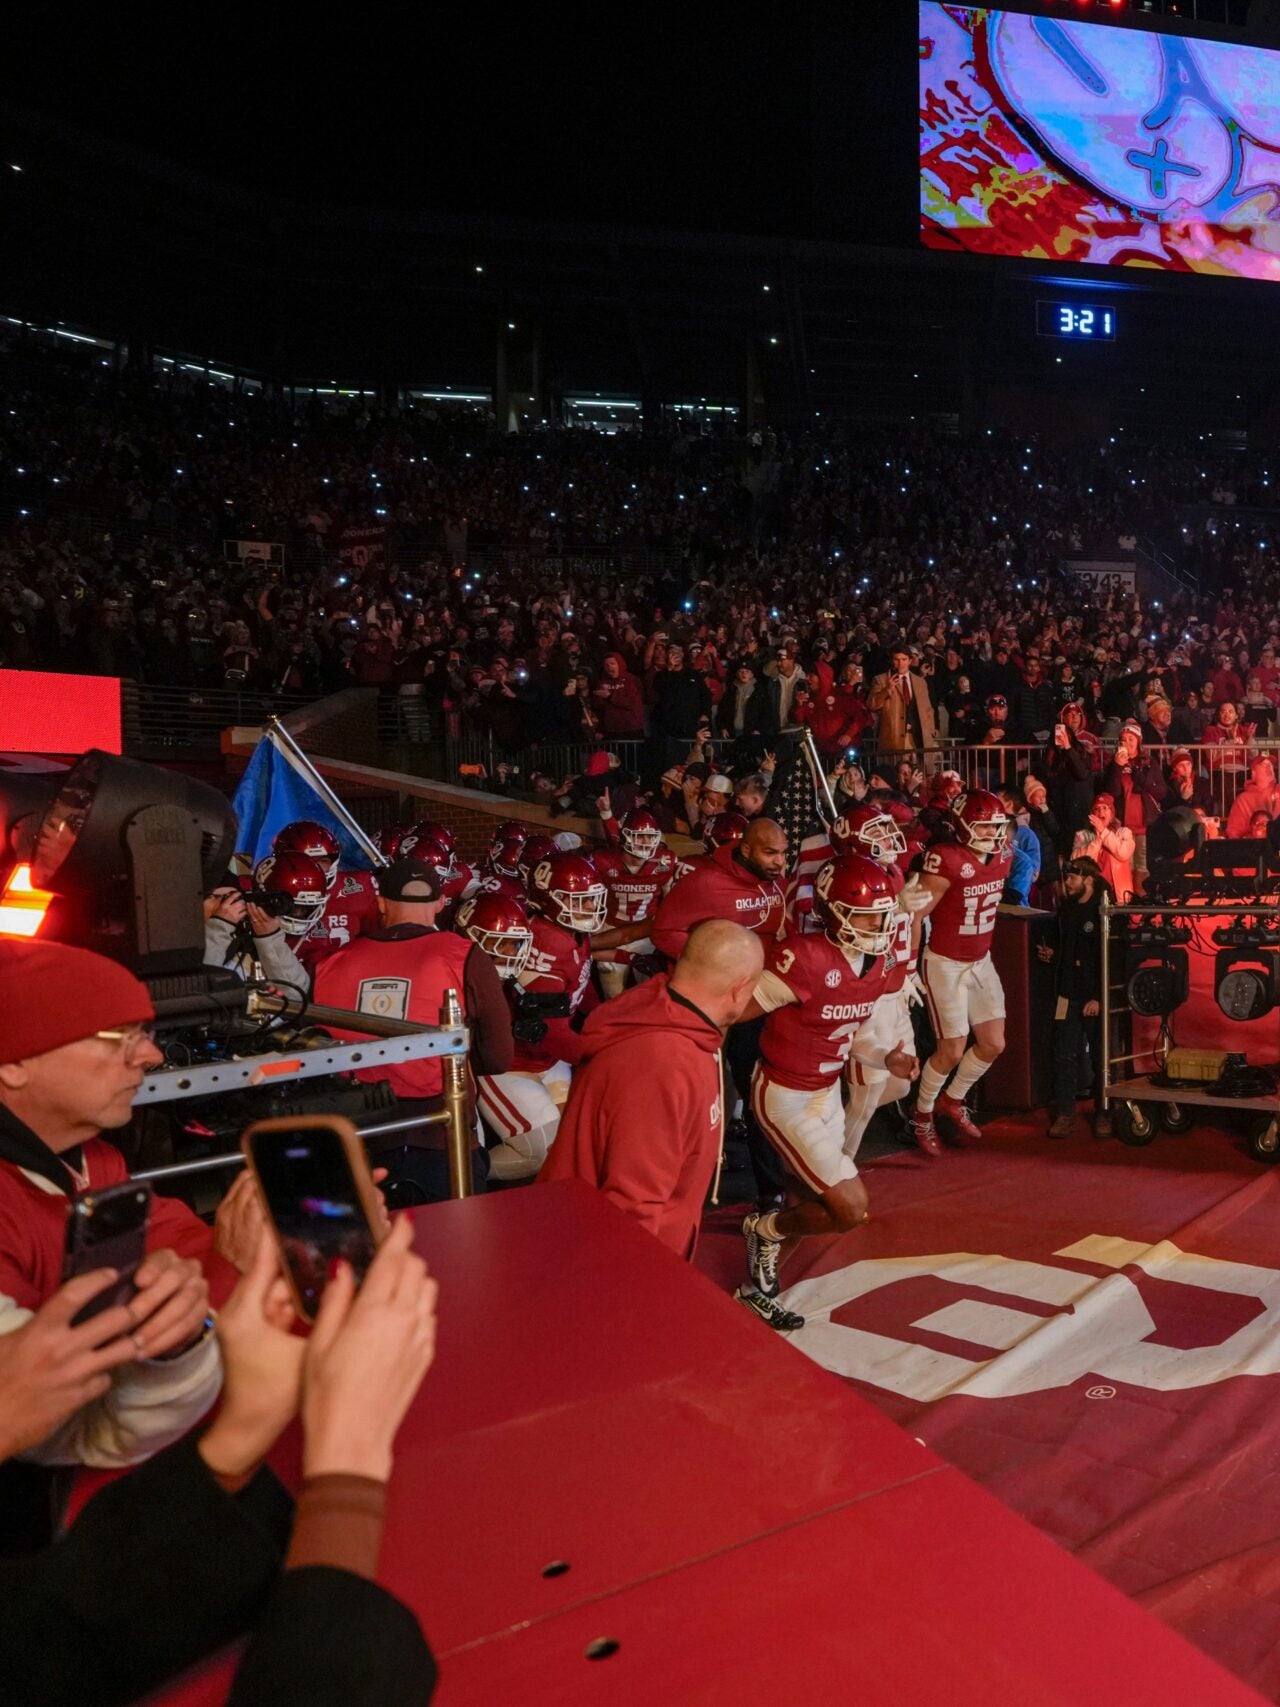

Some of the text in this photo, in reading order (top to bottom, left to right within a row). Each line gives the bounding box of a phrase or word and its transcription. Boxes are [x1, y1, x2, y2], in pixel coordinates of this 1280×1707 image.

[1060, 308, 1111, 334] 3:21
[922, 851, 942, 874] 12
[611, 884, 657, 892] SOONERS
[615, 892, 653, 921] 17
[959, 892, 1003, 935] 12
[776, 949, 795, 974] 3
[821, 1001, 876, 1020] SOONER
[819, 1021, 860, 1074] 3
